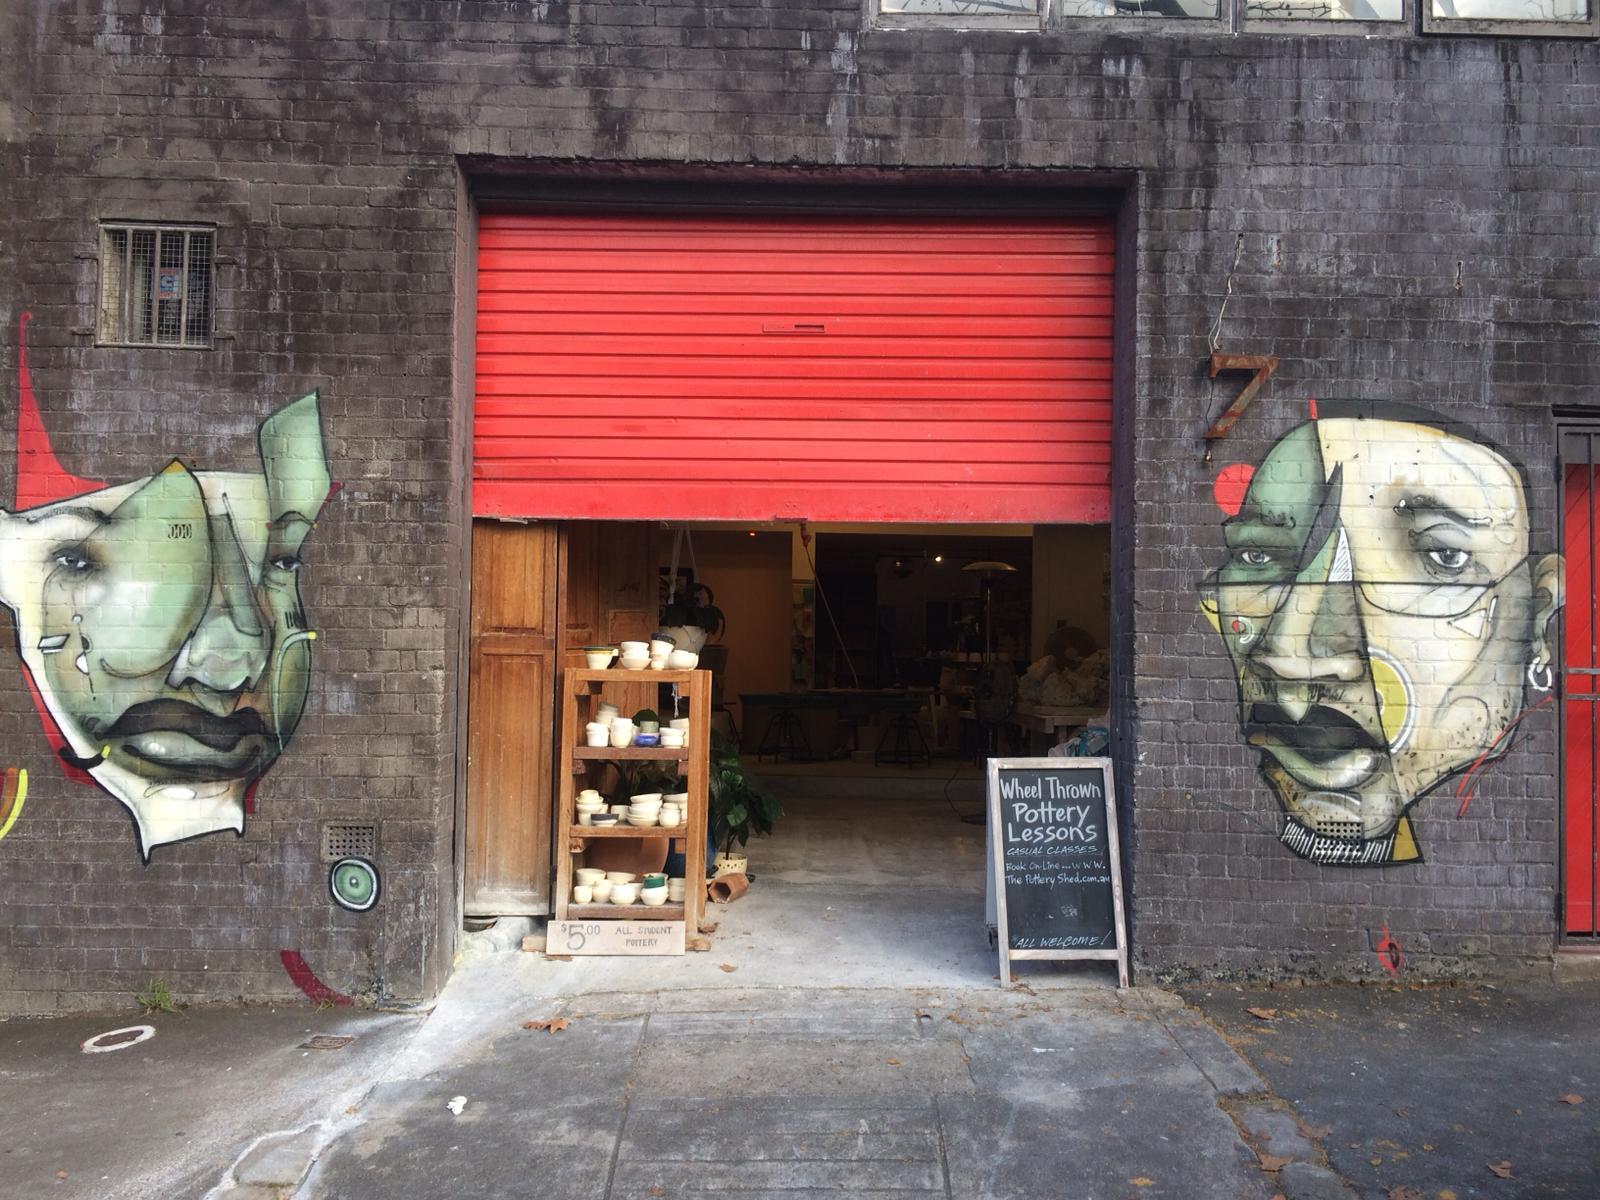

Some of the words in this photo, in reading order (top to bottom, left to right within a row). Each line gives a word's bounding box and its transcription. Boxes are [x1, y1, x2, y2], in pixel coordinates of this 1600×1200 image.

[1203, 353, 1278, 439] 7
[1000, 777, 1042, 800] Wheel
[1044, 776, 1101, 799] Thrown
[1012, 801, 1090, 828] Pottery
[1008, 822, 1098, 843] Lessons
[1007, 846, 1043, 856] CASUAL
[1046, 845, 1098, 855] CLASSES
[1005, 861, 1027, 871] Book
[1005, 874, 1023, 885] The
[1025, 873, 1056, 890] Pottery
[615, 926, 632, 935] ALL
[638, 926, 672, 935] STUDENT
[625, 938, 658, 947] POTTERY
[1015, 937, 1036, 948] ALL
